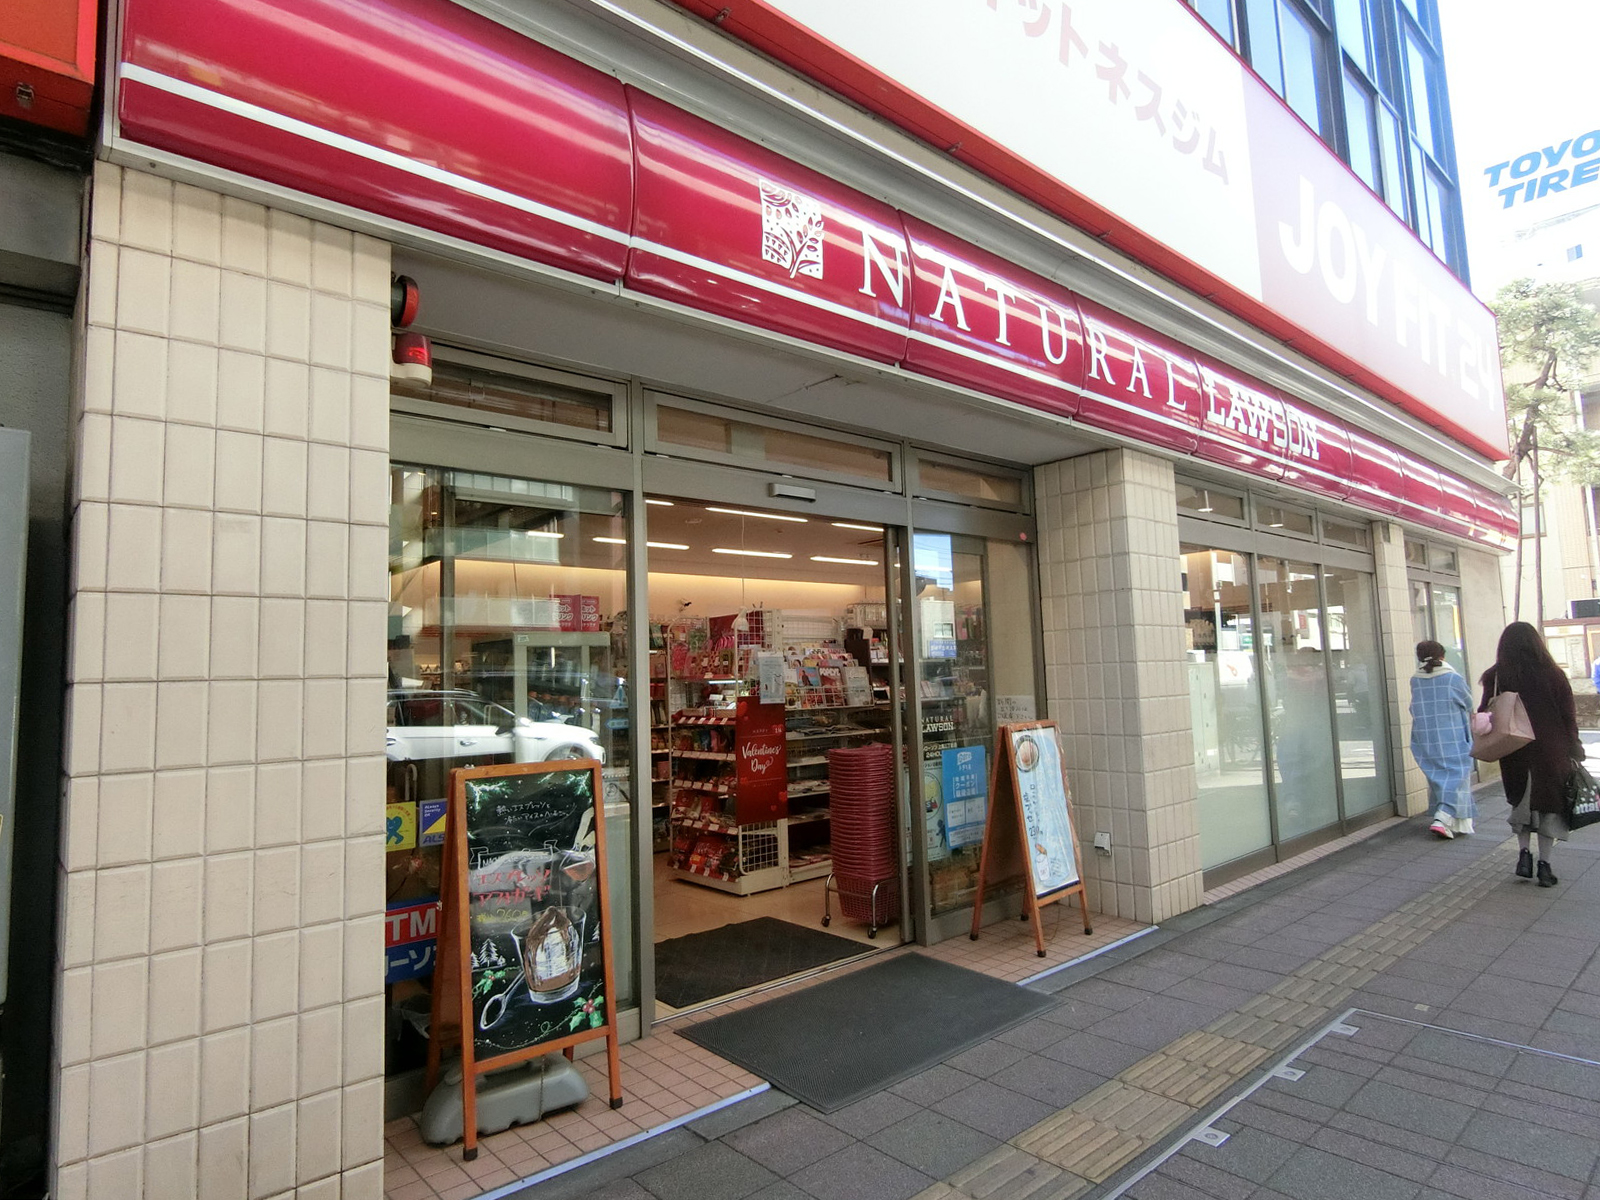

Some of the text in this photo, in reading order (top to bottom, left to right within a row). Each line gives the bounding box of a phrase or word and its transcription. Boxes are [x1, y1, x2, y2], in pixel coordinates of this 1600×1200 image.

[987, 0, 1229, 185] ットネスジム
[1483, 129, 1600, 188] TOYO
[1498, 157, 1600, 210] TIRE
[858, 228, 1321, 461] NATURAL LAWSON
[1457, 320, 1496, 413] 24
[921, 722, 954, 733] LAWSON
[751, 757, 774, 775] Day
